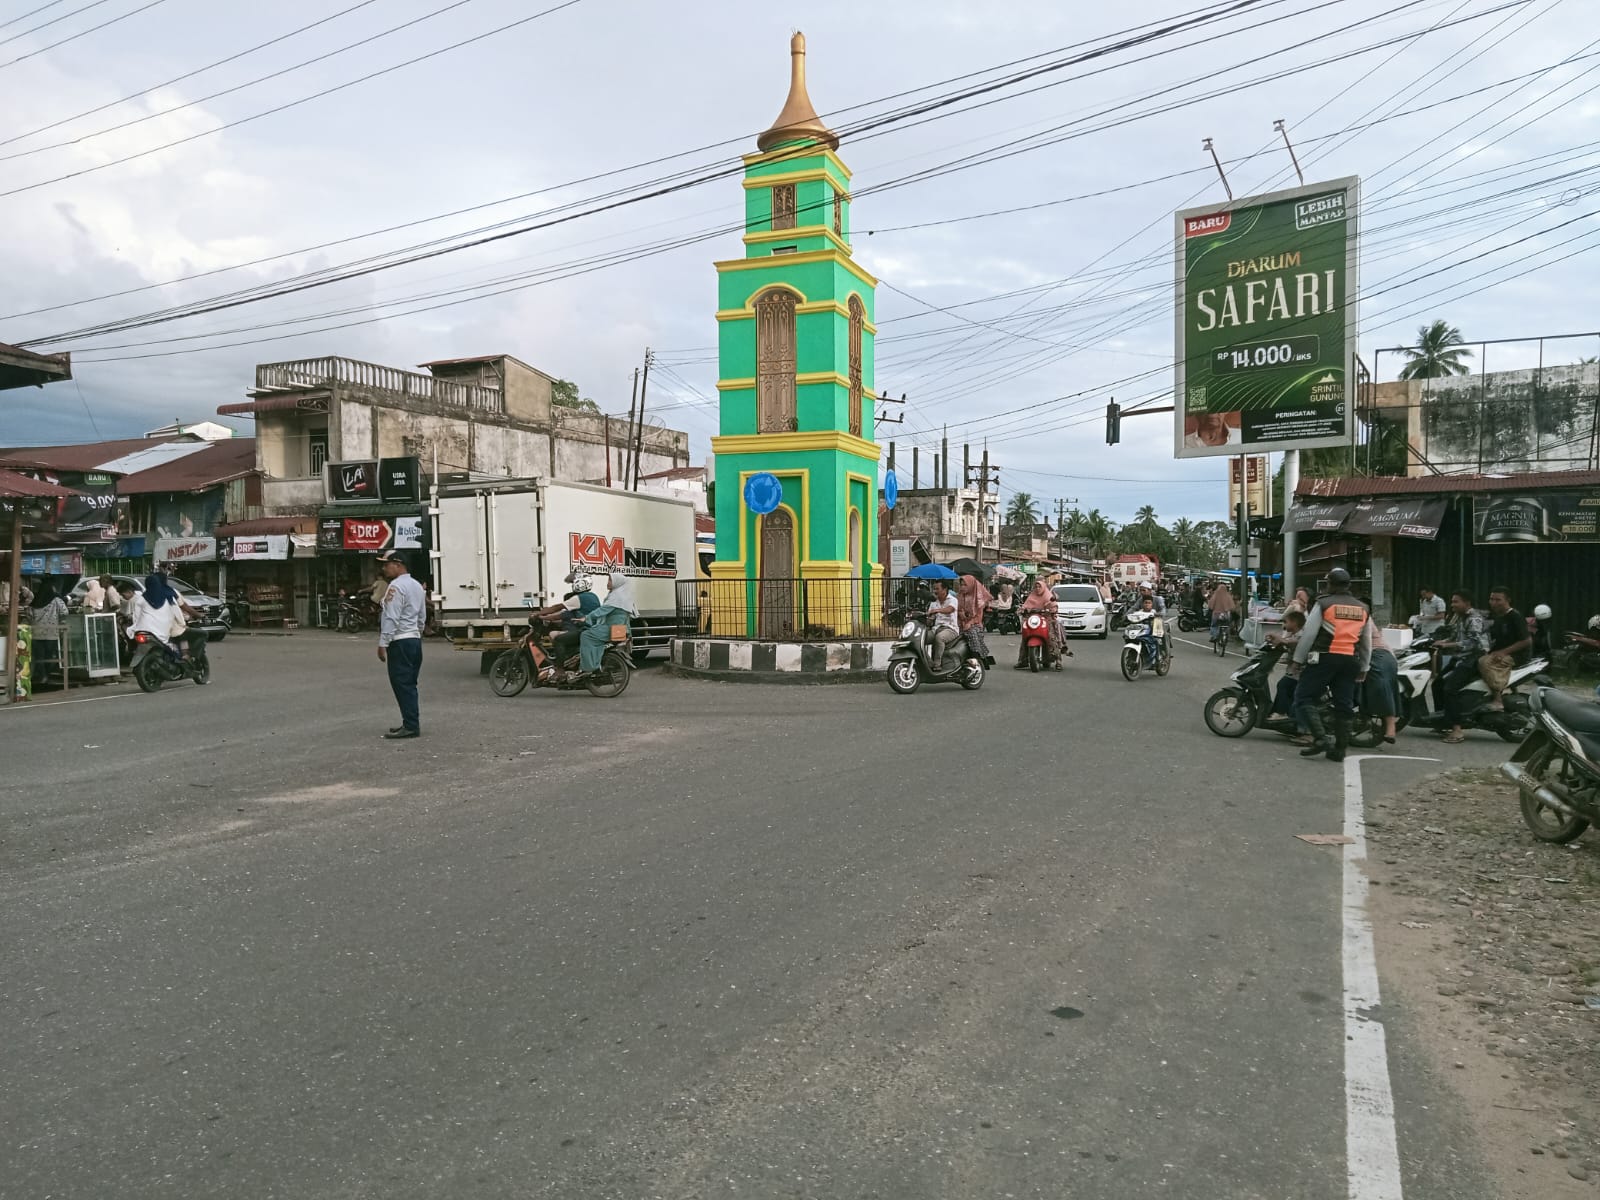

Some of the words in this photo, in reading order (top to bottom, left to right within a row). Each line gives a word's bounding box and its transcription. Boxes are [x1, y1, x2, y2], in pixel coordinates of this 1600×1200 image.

[1299, 195, 1343, 216] LEBIH
[1189, 216, 1225, 231] BARU
[1300, 209, 1344, 226] MANTAP
[1197, 269, 1336, 332] SAFARI
[1217, 352, 1229, 361] RP
[1231, 344, 1292, 368] 14.000
[1491, 512, 1538, 523] MAGNUM
[357, 525, 380, 538] DRP
[237, 544, 253, 553] DRP
